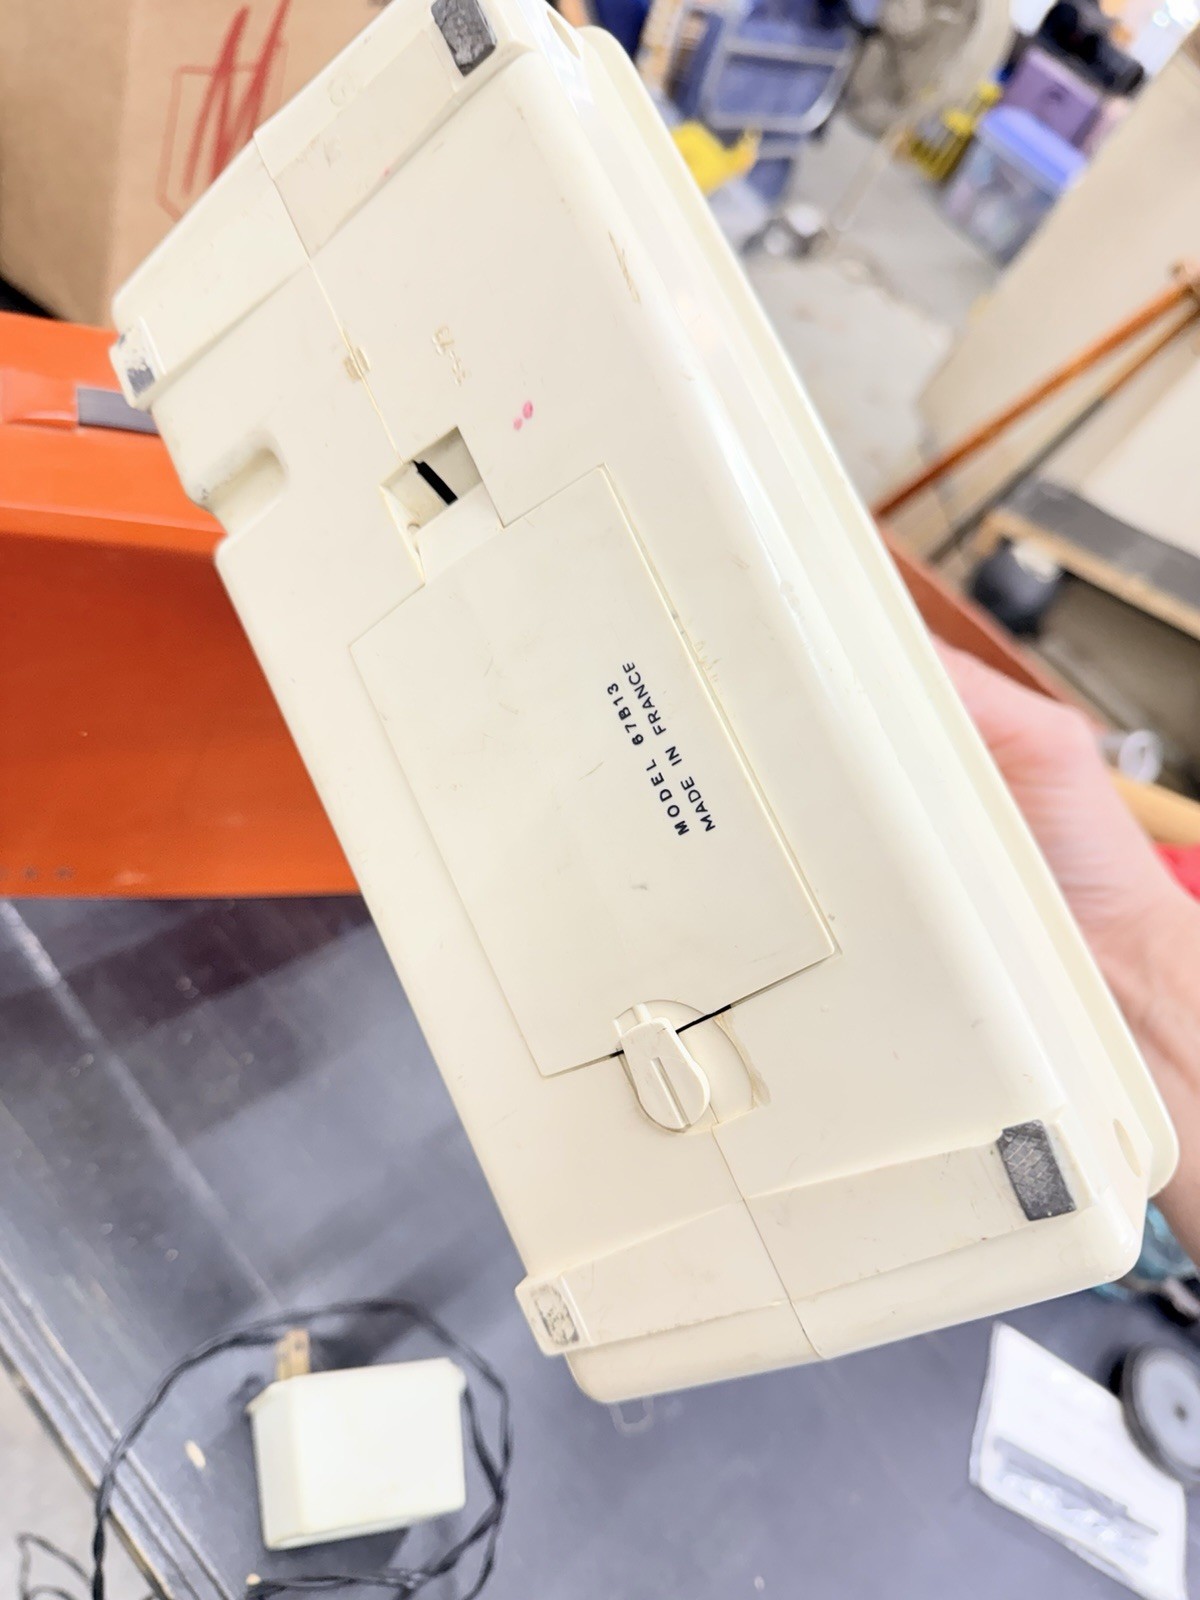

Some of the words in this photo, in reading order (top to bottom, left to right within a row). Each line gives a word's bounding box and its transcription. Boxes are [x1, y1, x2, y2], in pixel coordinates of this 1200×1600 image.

[606, 682, 644, 746] 67B13
[622, 662, 667, 736] FRANCE
[665, 745, 683, 767] IN
[646, 758, 690, 836] MODEL
[680, 776, 716, 832] MADE
